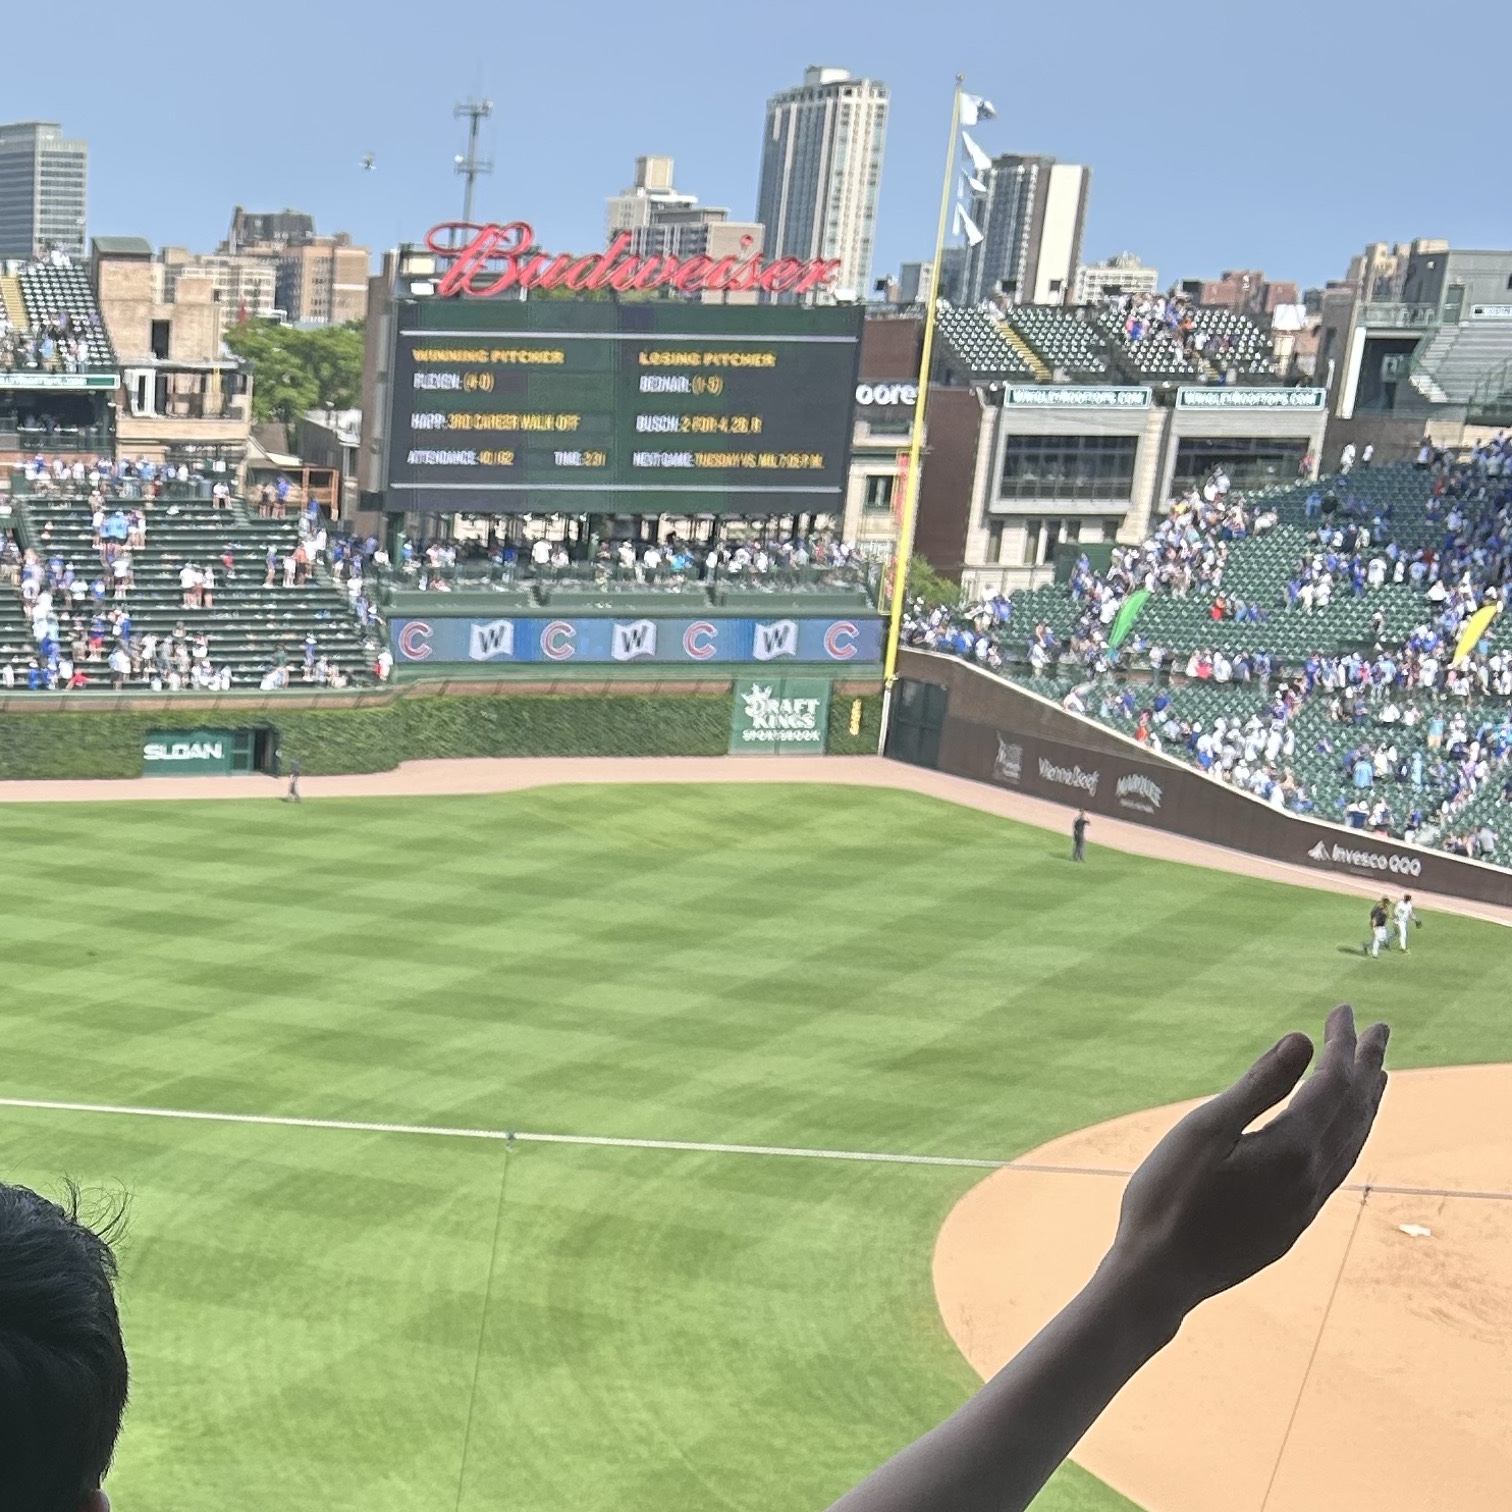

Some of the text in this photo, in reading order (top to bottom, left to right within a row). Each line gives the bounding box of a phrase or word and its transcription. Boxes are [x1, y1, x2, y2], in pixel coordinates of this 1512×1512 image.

[425, 221, 841, 296] Budweiser
[412, 349, 565, 365] WINNING PITCHER
[639, 352, 776, 368] LOSING PITCHER
[398, 621, 858, 660] C W C W C W C
[745, 698, 820, 717] DRAFT
[752, 713, 816, 729] KINGS
[143, 742, 223, 760] SLOAN
[1332, 843, 1422, 877] Invesco QQQ
